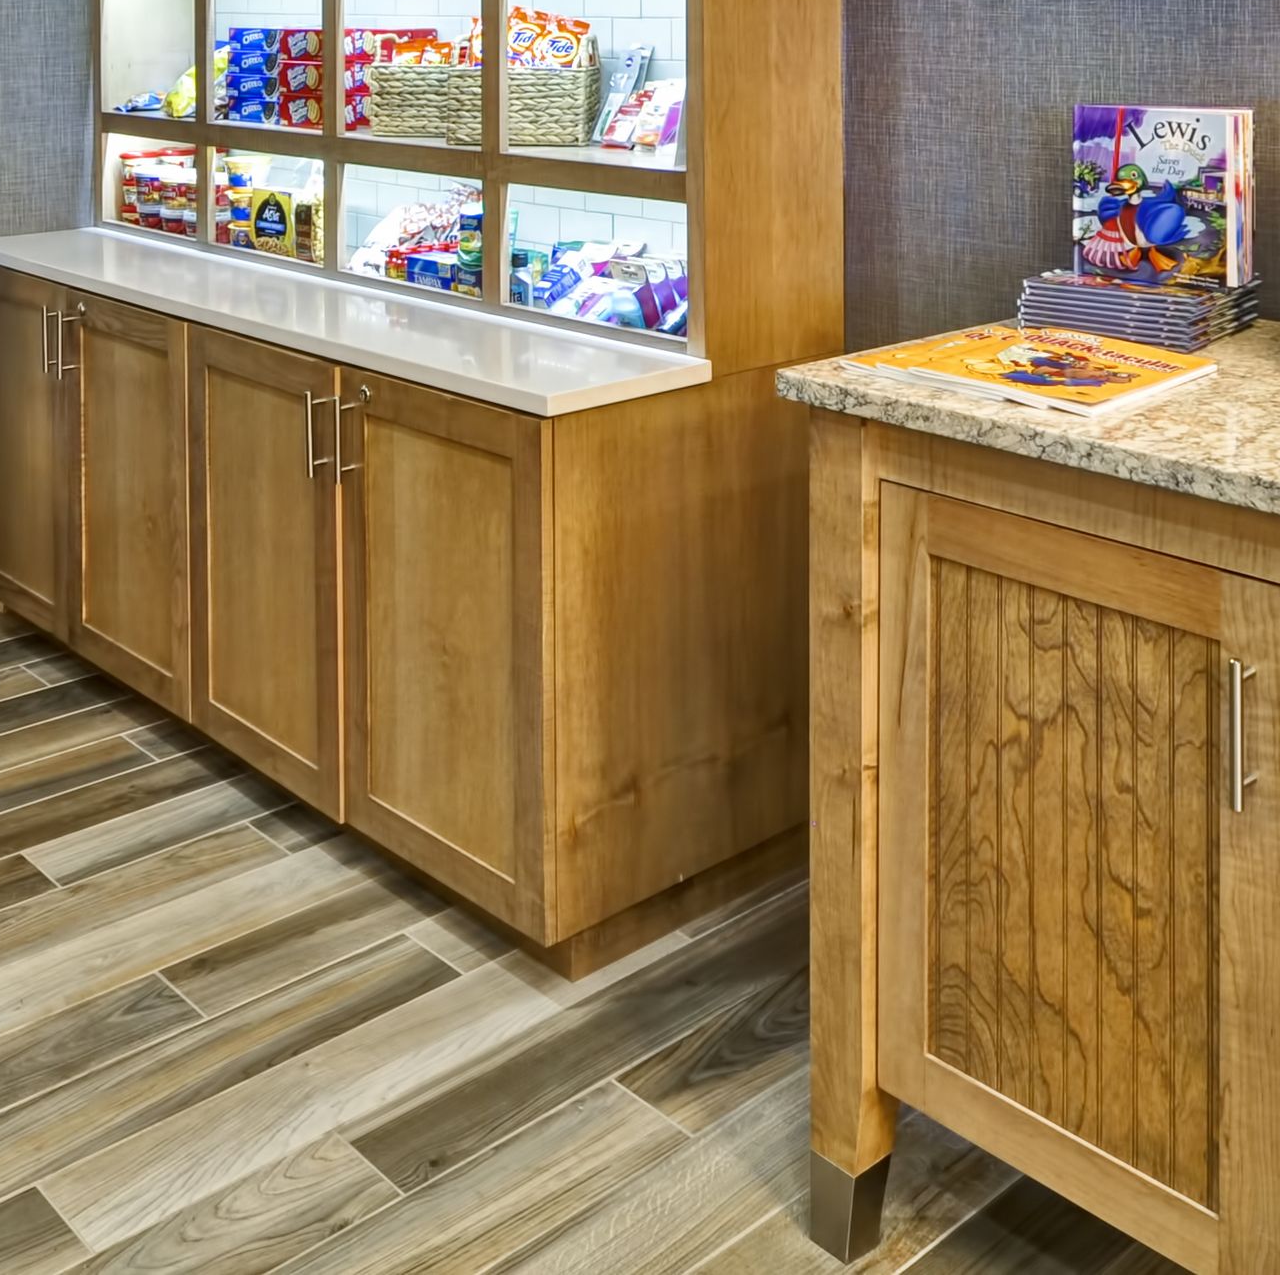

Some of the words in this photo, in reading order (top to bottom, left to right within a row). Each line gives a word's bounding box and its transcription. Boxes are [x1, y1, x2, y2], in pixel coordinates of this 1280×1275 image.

[513, 31, 535, 44] Tid
[549, 39, 574, 53] Tide
[1126, 118, 1211, 151] Lewis
[1161, 139, 1180, 150] The
[1157, 155, 1180, 165] Saves
[1151, 165, 1166, 174] the
[1167, 166, 1186, 177] Day
[414, 275, 442, 288] TAMPAX
